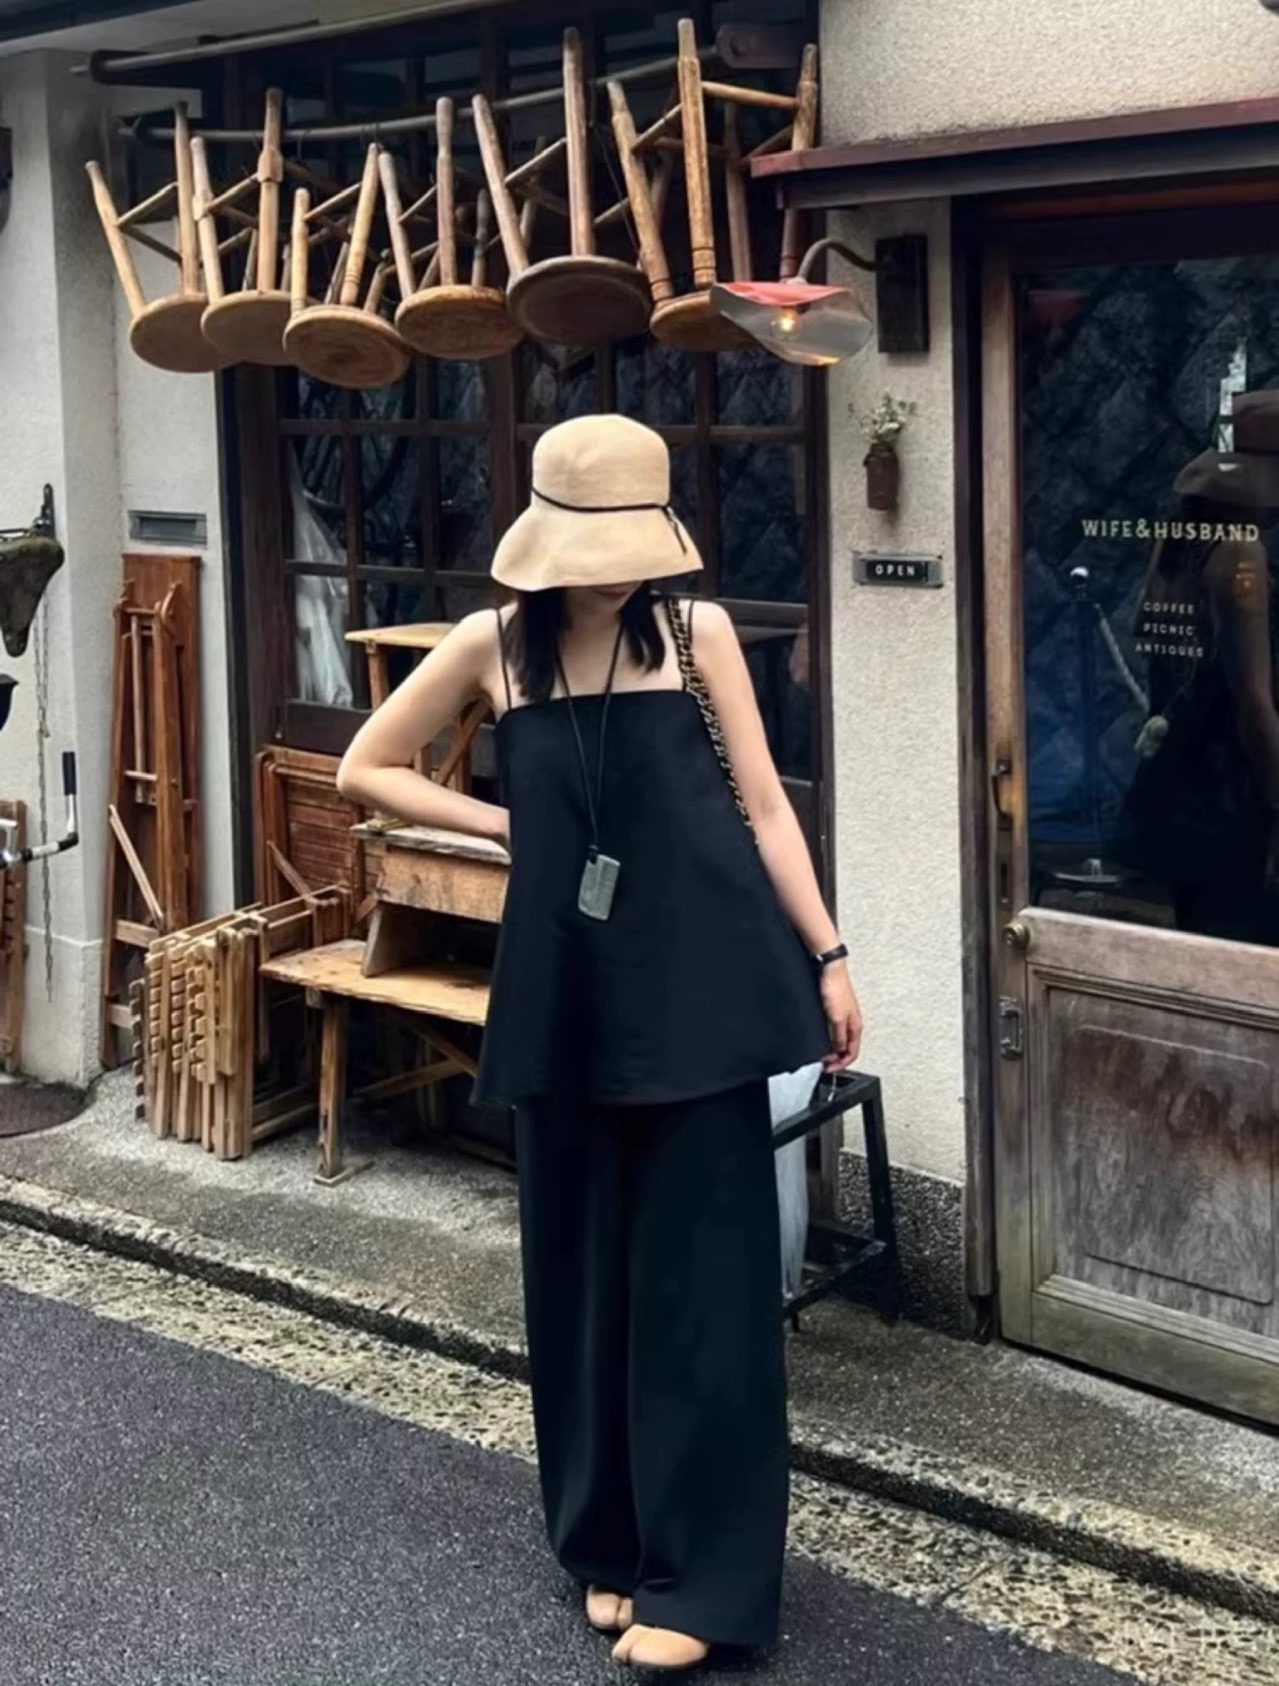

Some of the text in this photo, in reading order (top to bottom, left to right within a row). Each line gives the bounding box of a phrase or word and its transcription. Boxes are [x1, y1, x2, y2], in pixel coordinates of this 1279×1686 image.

[1082, 518, 1260, 542] WIFE&HUSBAND
[875, 564, 915, 576] OPEN
[1143, 602, 1194, 614] COFFEE
[1143, 623, 1194, 635] PICNIC
[1135, 643, 1203, 657] ANTIQUES
